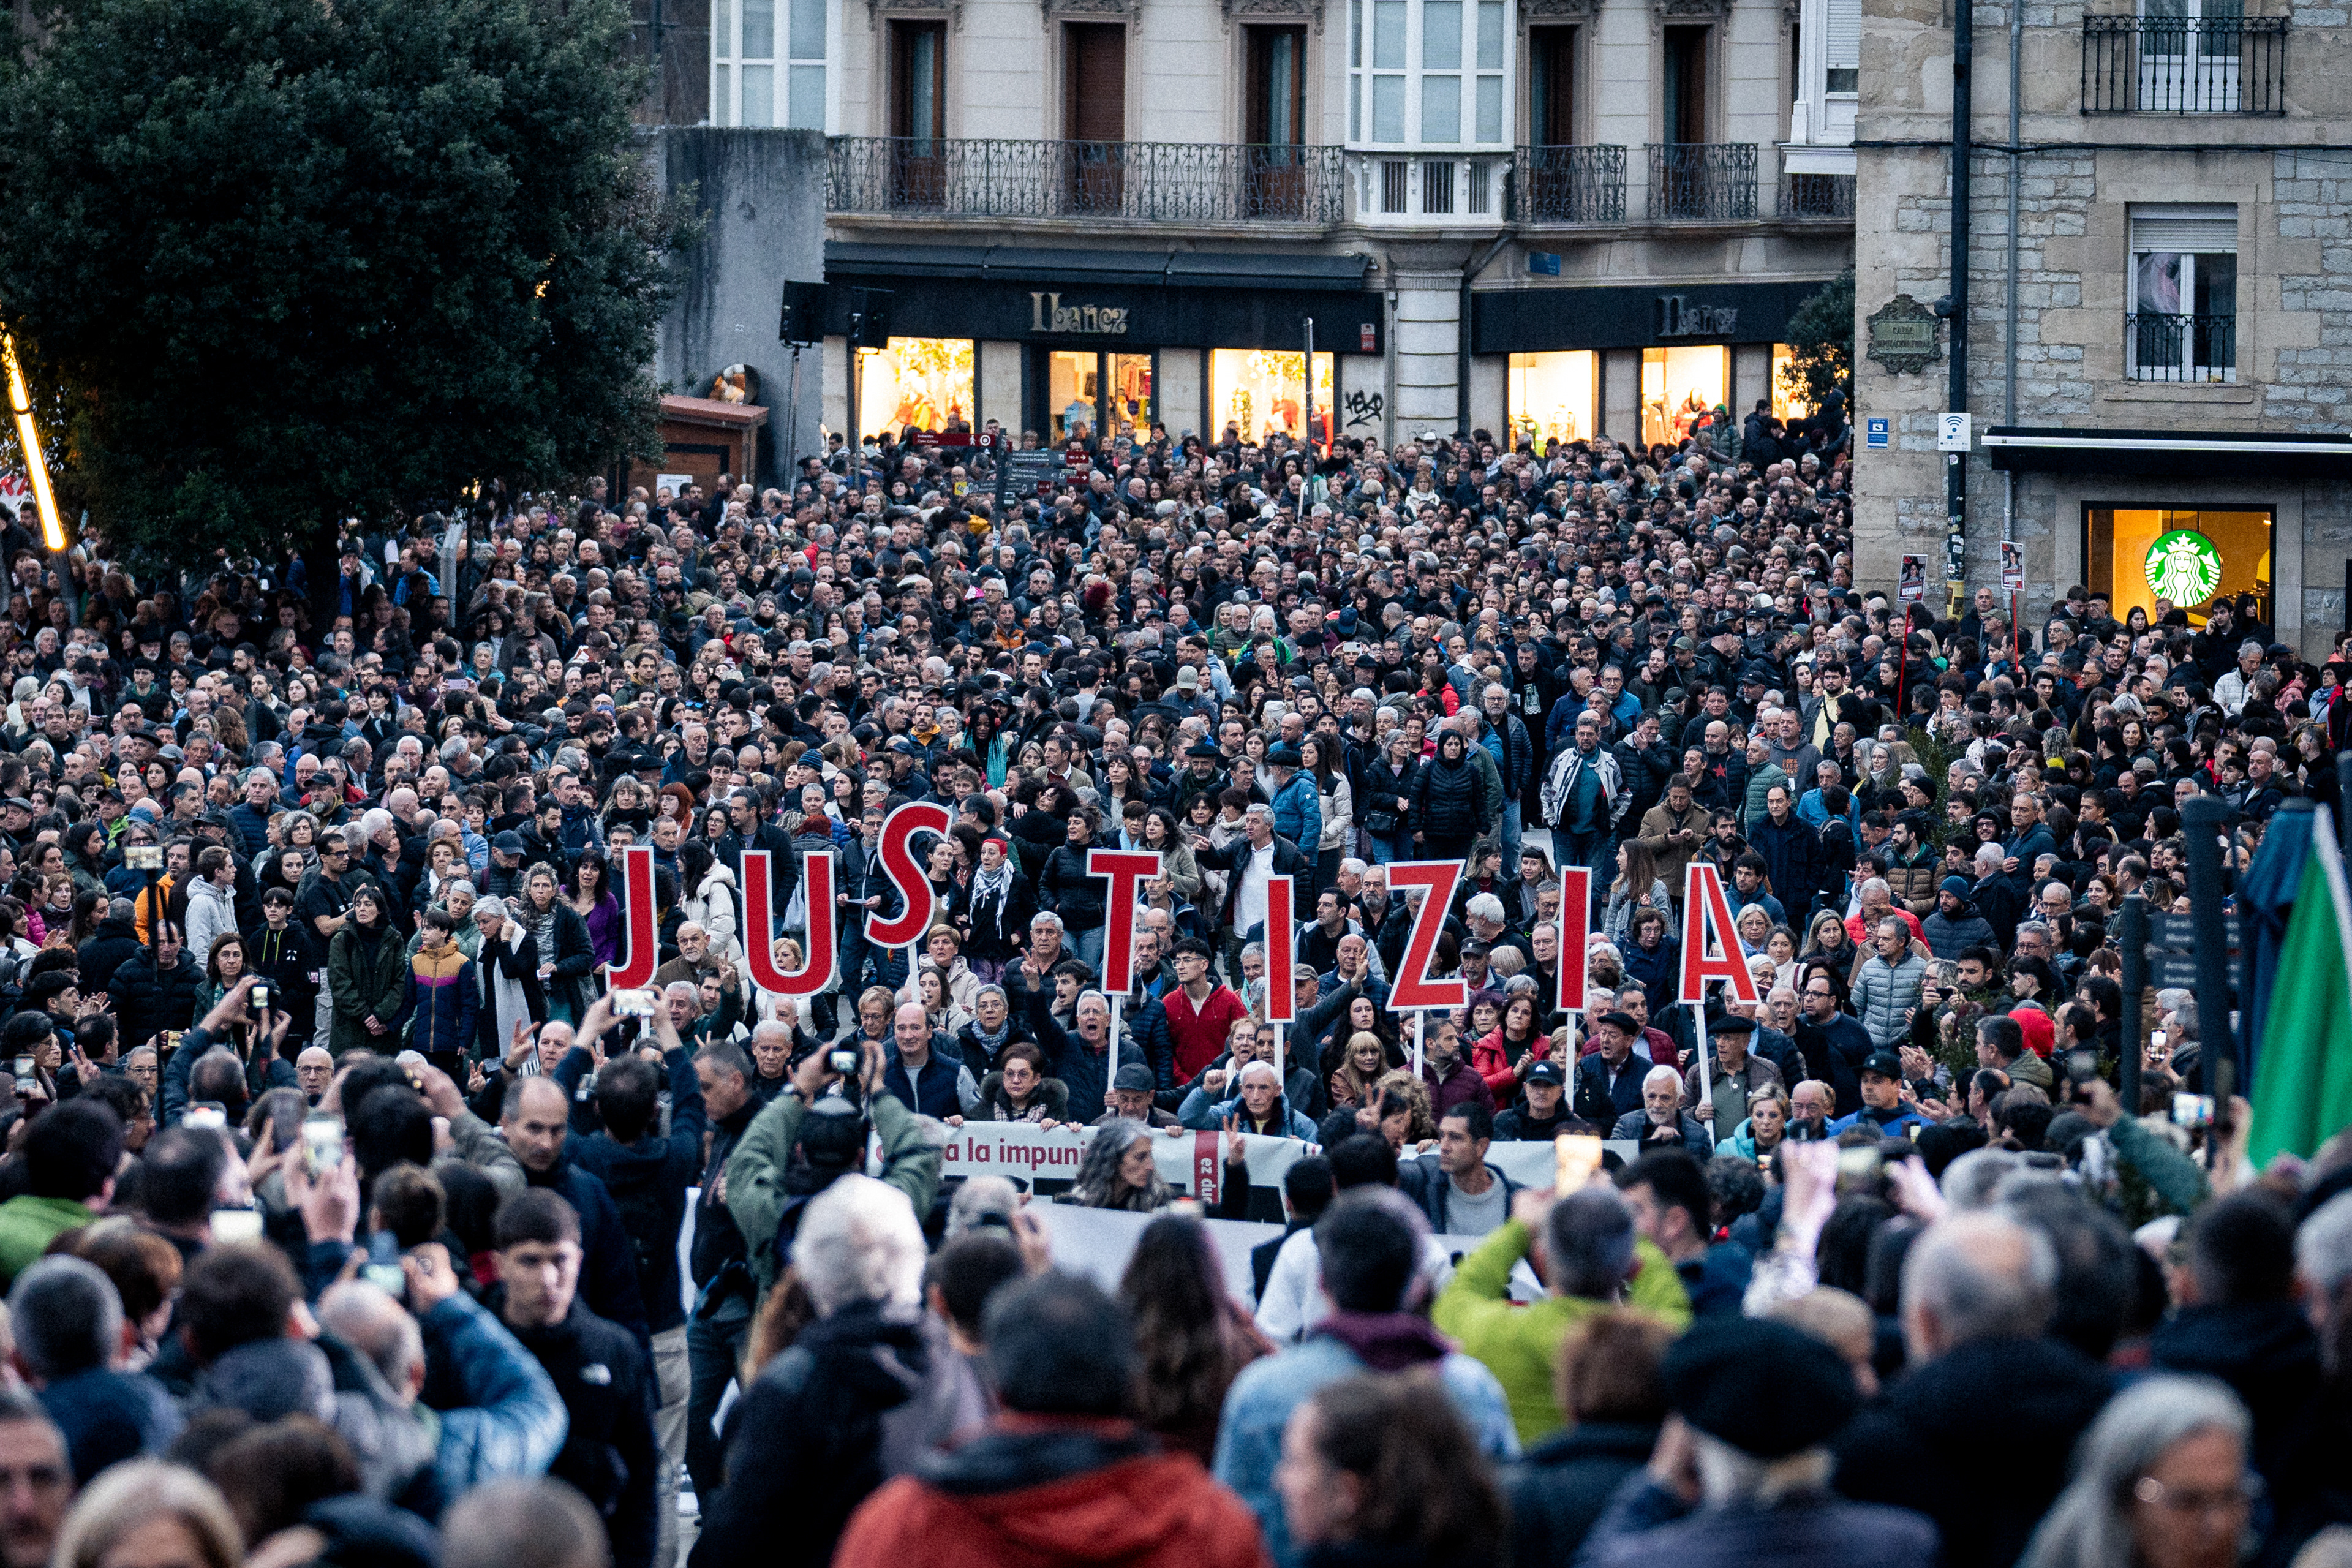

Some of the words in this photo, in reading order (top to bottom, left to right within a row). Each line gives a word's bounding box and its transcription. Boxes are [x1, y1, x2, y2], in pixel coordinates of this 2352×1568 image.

[1030, 292, 1128, 334] Ibañez
[968, 1137, 990, 1162] la
[1200, 1158, 1212, 1174] ez
